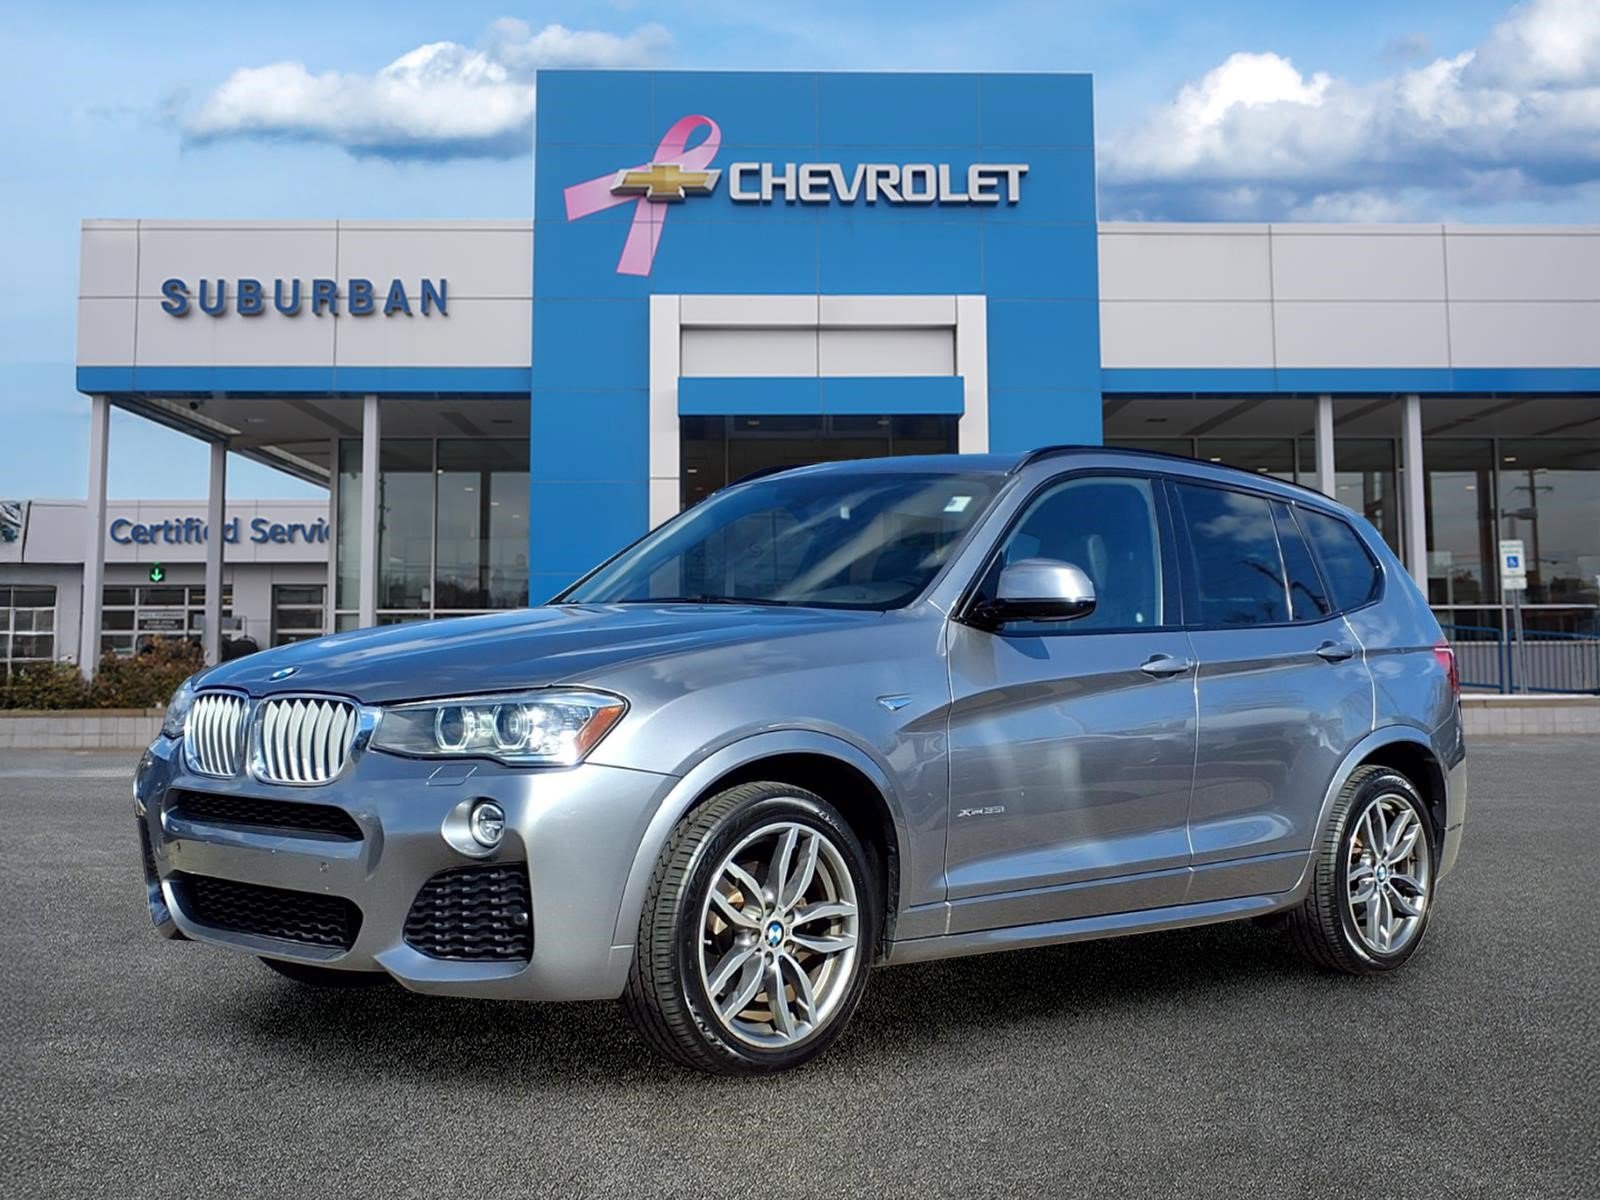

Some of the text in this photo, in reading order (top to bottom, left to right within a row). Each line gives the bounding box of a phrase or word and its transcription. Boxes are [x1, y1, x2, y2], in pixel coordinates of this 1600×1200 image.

[729, 161, 1029, 205] CHEVROLET
[161, 278, 449, 316] SUBURBAN
[110, 517, 240, 544] Certifid
